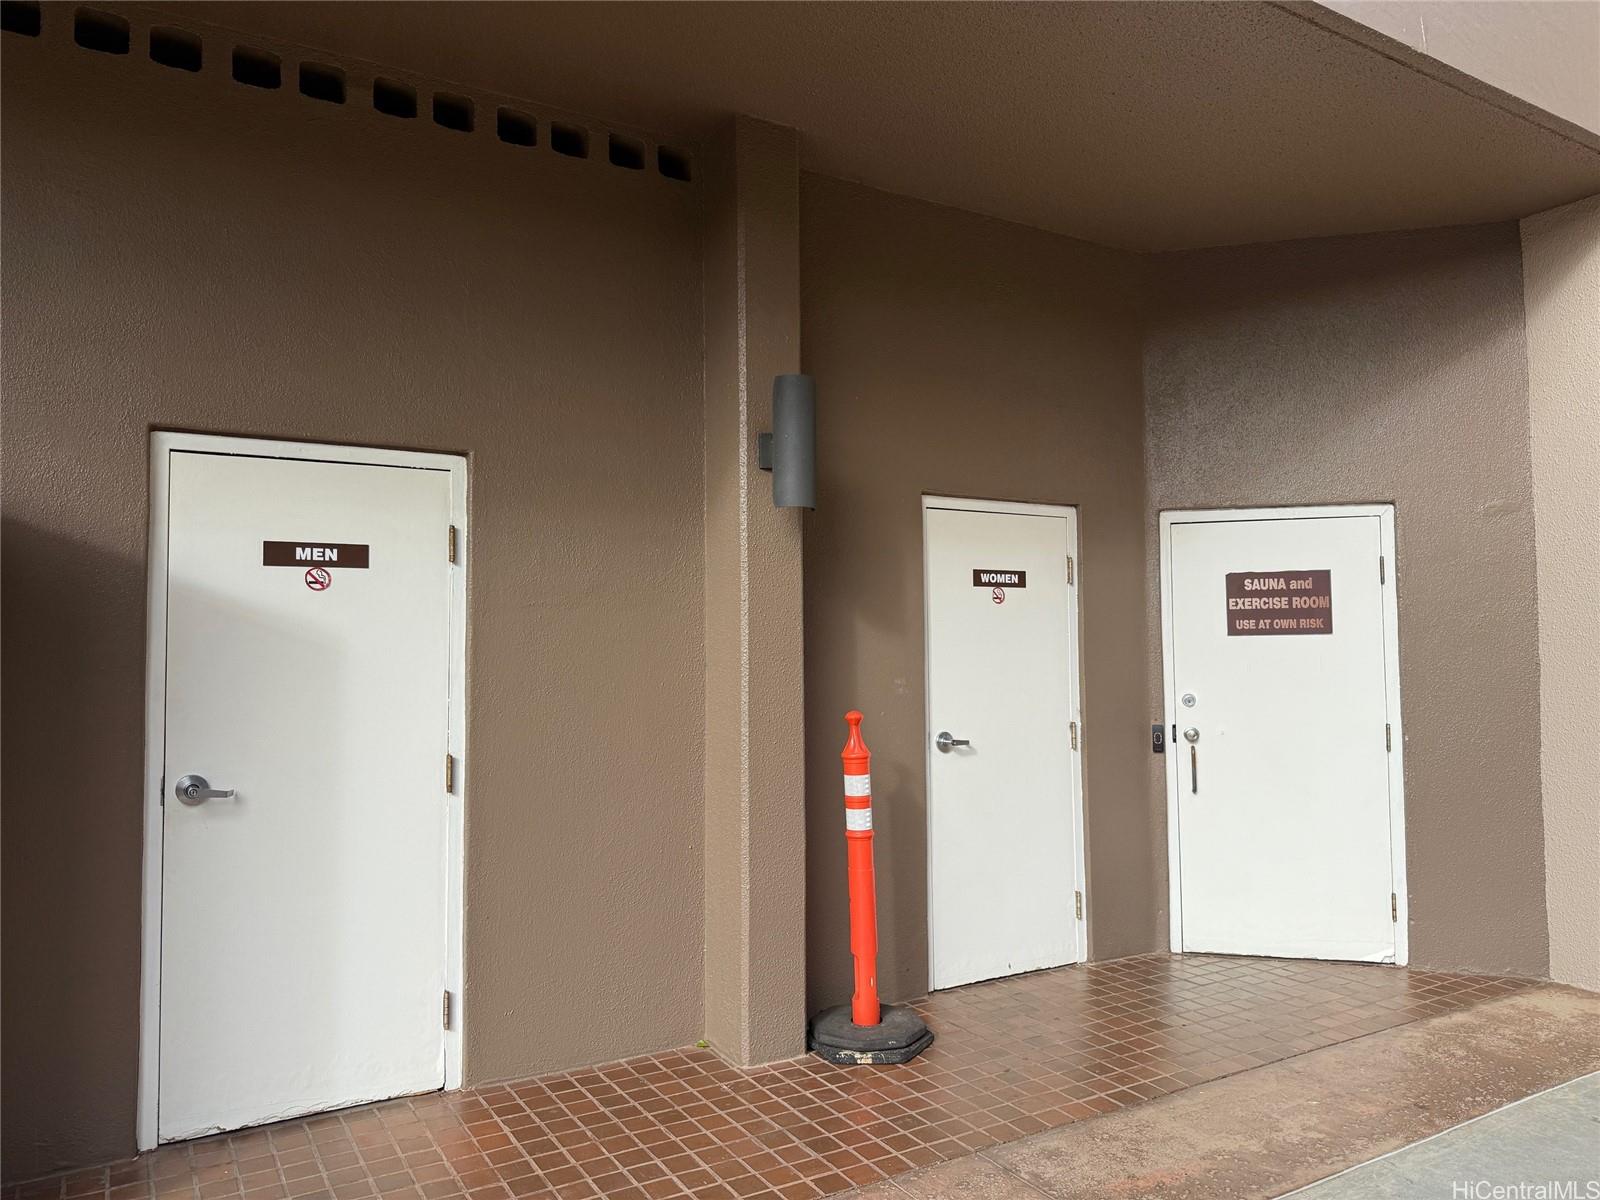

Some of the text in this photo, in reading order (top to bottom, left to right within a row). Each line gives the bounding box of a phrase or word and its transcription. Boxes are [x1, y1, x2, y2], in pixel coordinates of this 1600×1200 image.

[295, 547, 338, 561] MEN
[980, 573, 1019, 584] WOMEN
[1244, 577, 1313, 591] SAUNA and
[1228, 596, 1330, 610] EXERCISE ROOM
[1236, 618, 1324, 630] USE AT OWN RISK
